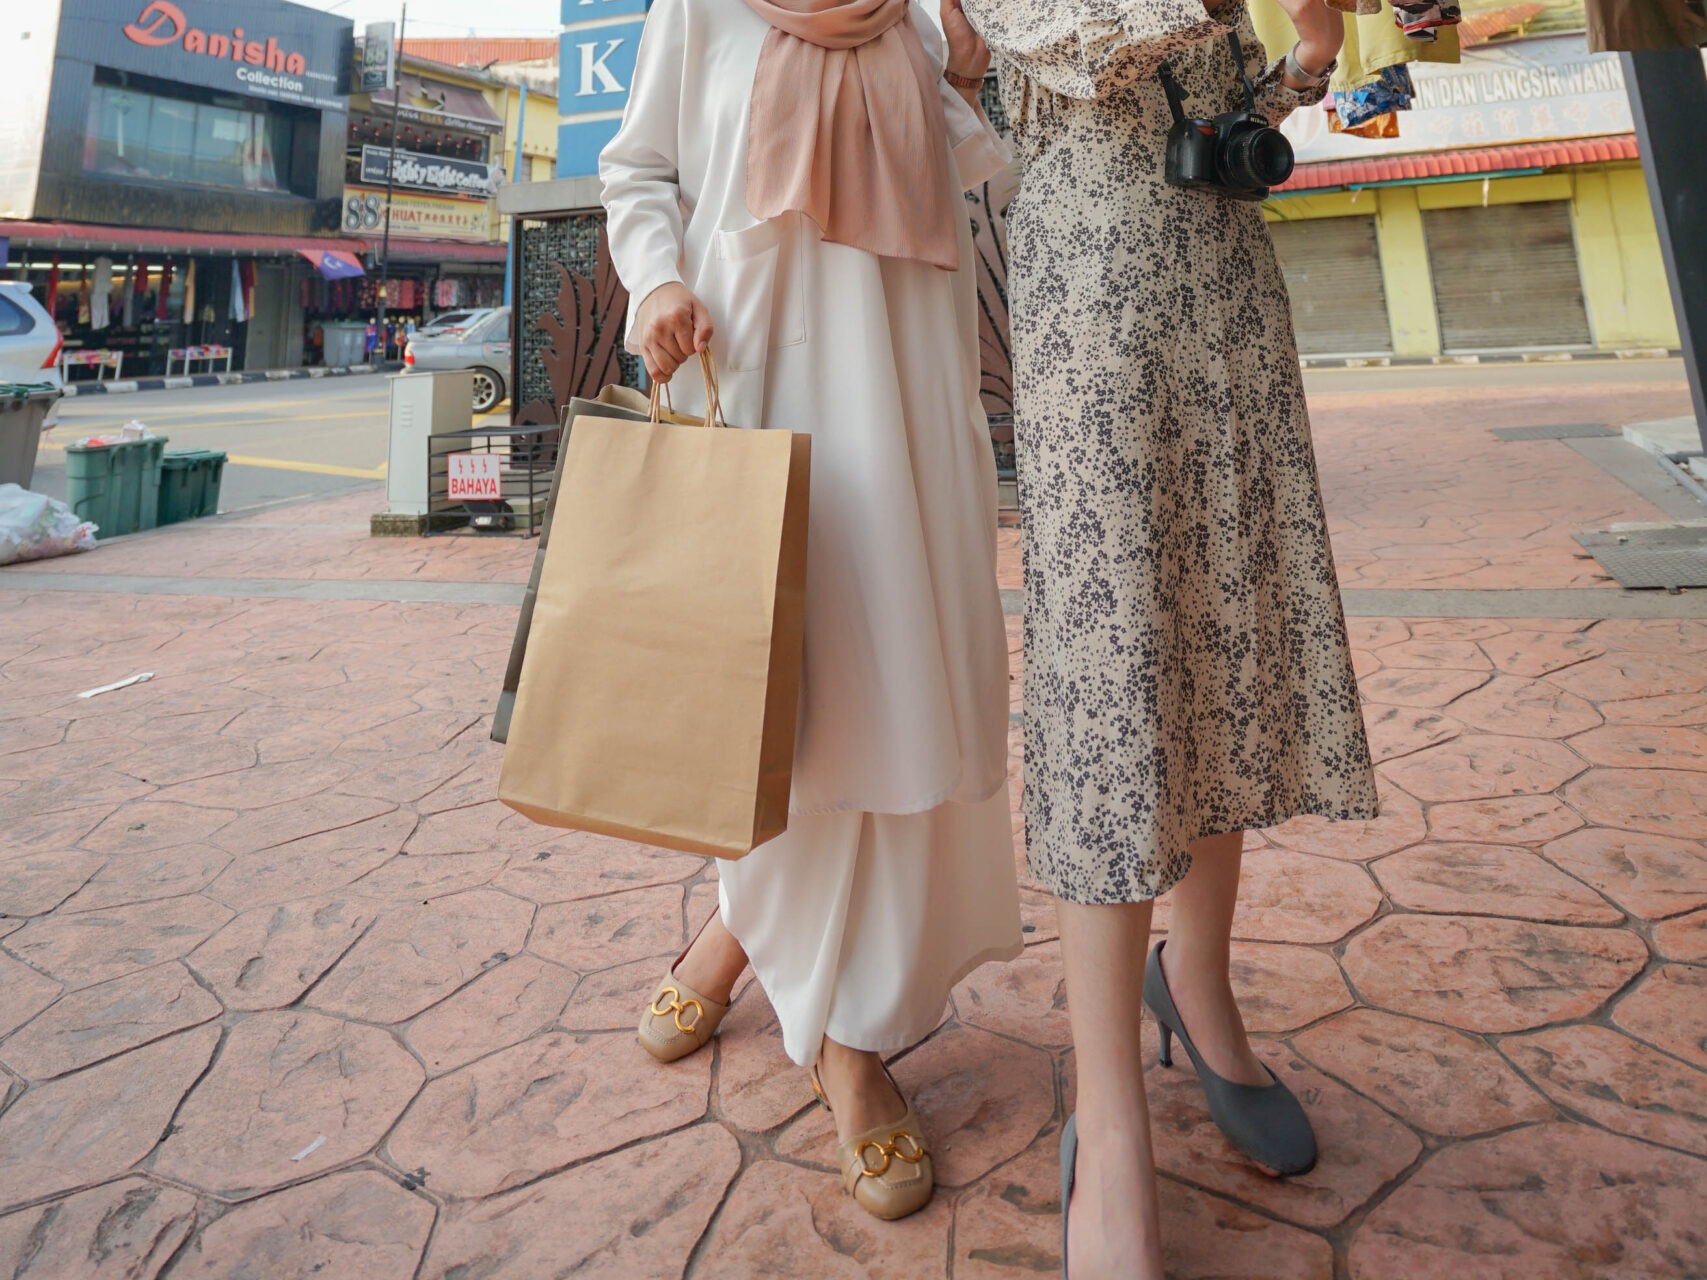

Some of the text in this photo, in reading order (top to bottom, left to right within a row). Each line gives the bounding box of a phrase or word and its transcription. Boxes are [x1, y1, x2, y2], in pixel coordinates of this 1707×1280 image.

[123, 0, 305, 75] Danisha
[236, 67, 303, 92] Collection
[1410, 79, 1435, 110] IN
[1438, 74, 1477, 107] DAN
[1481, 66, 1563, 103] LANGSIR
[392, 207, 422, 223] HUAT
[451, 478, 497, 494] BAHAYA
